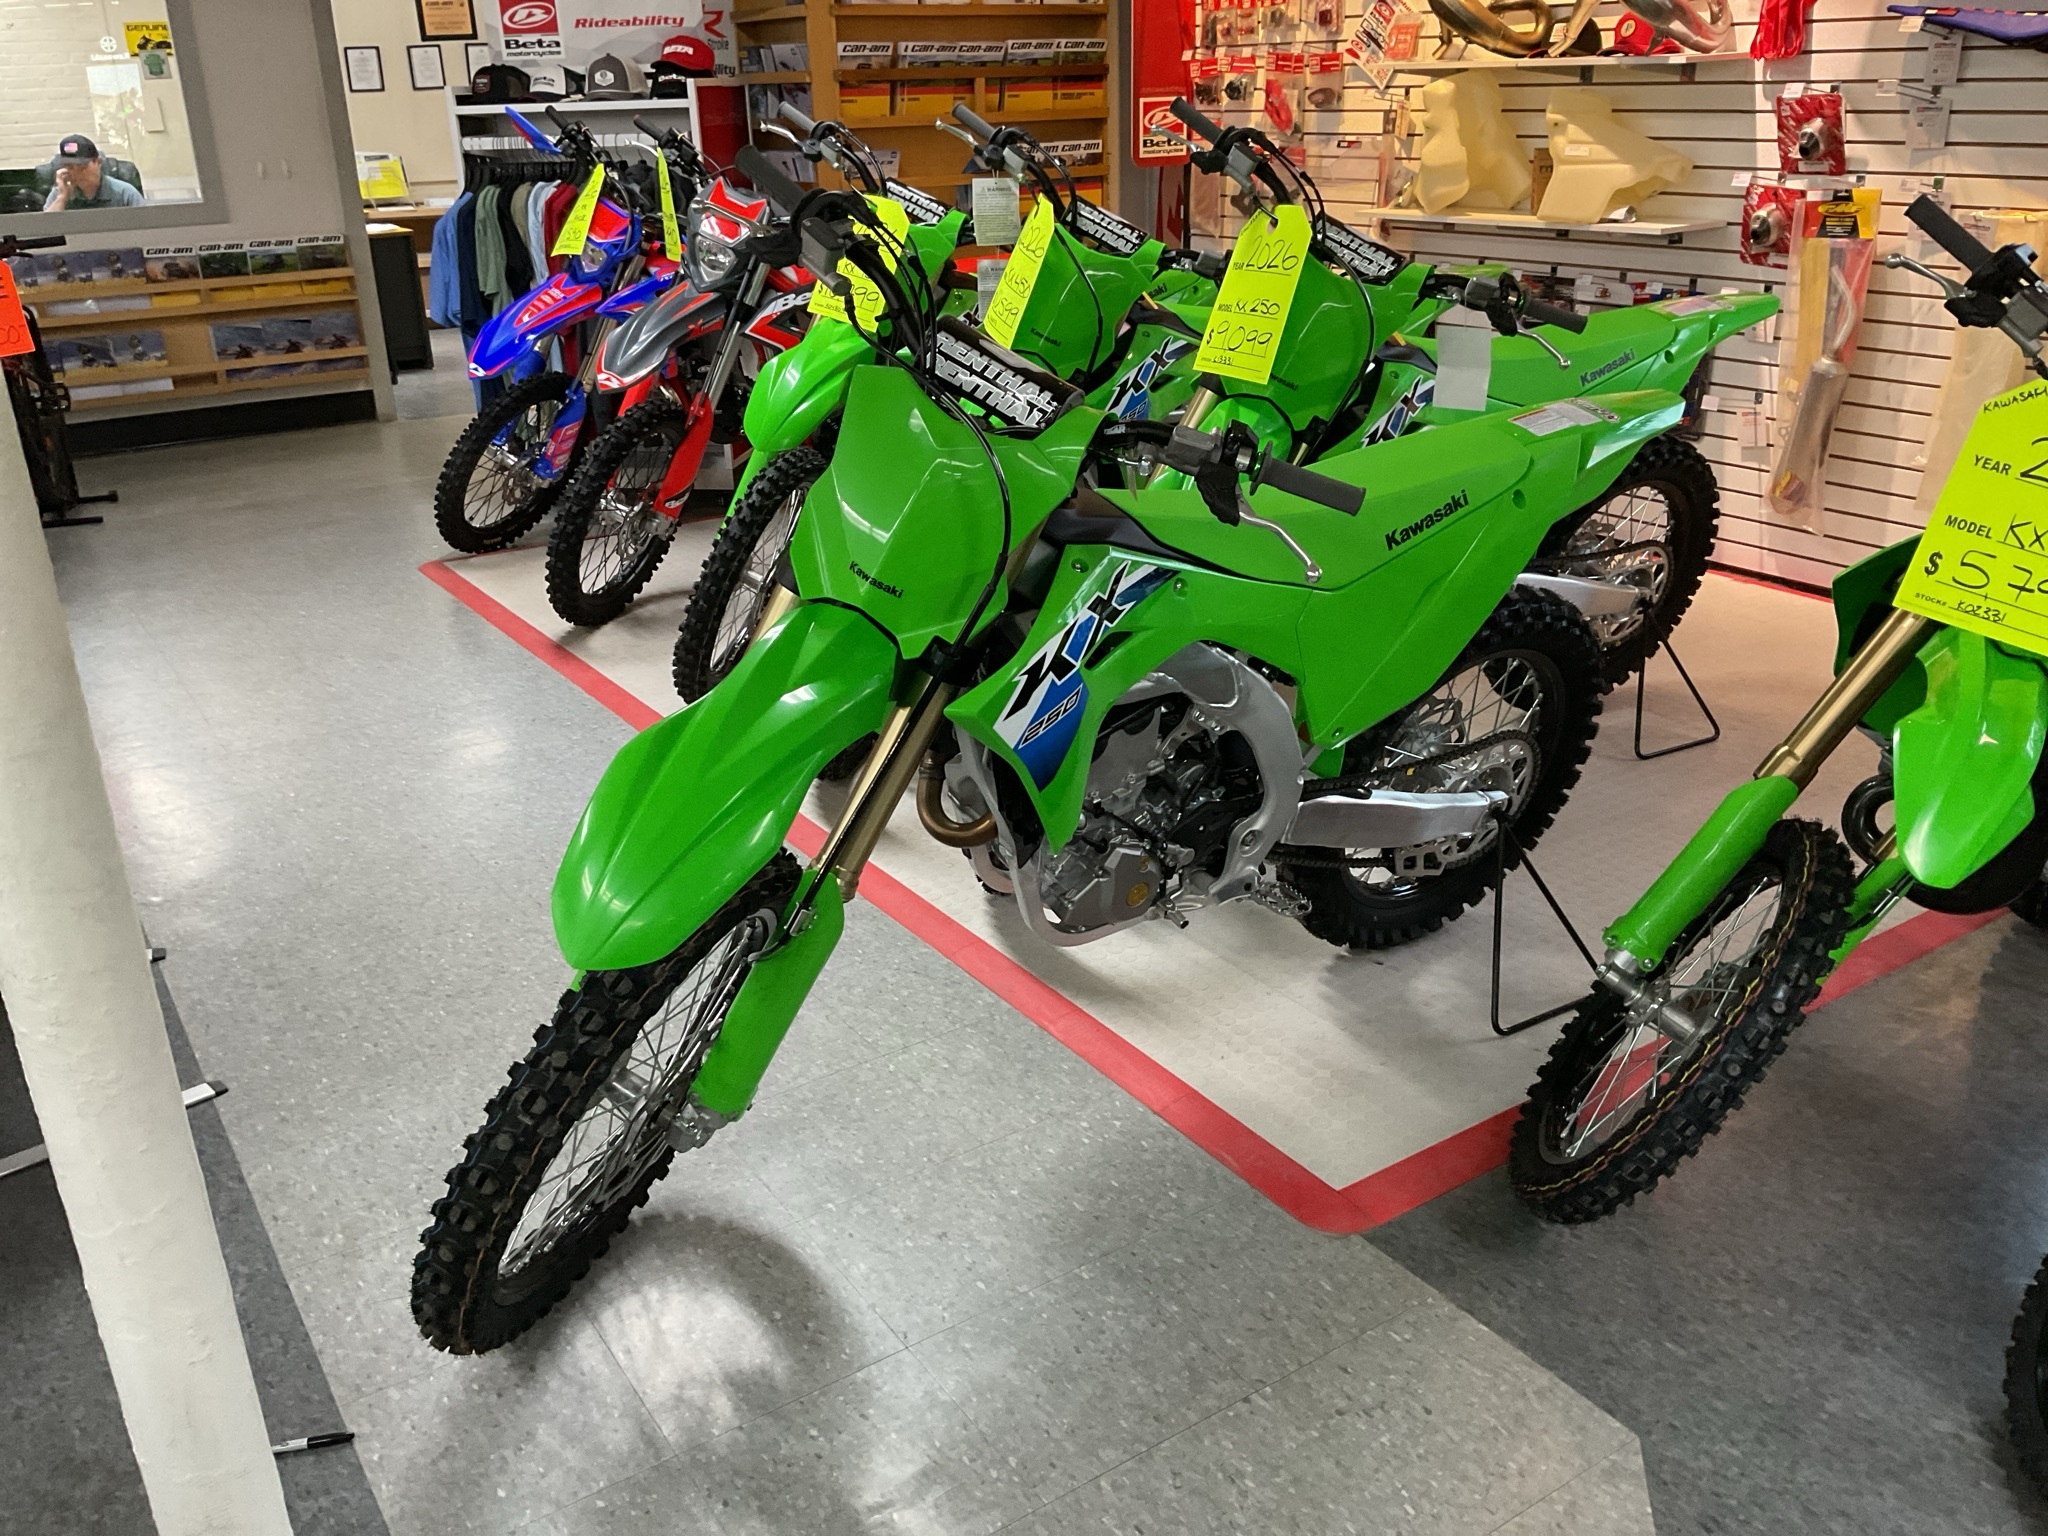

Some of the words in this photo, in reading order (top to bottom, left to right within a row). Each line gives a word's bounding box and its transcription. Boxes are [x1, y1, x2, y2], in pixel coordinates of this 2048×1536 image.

[574, 15, 684, 29] Rideability
[504, 38, 561, 50] Beta
[842, 43, 891, 54] can-am
[911, 43, 957, 53] can-am
[958, 44, 1004, 53] can-am
[1011, 41, 1054, 50] can-am
[1064, 40, 1105, 50] can-am
[506, 50, 561, 58] motorcycles
[1061, 142, 1101, 153] can-am
[249, 238, 293, 248] can-am
[297, 234, 341, 245] can-am
[146, 246, 193, 256] can-am
[199, 242, 243, 252] can-am
[1245, 234, 1299, 271] 2026
[1249, 299, 1281, 315] 250
[936, 330, 1056, 412] RENTHAL
[1579, 348, 1636, 387] Kawasaki
[1973, 454, 2012, 476] YEAR
[1384, 488, 1470, 551] Kawasaki
[1944, 514, 1993, 540] MODEL
[849, 559, 904, 599] Kawasaki
[1018, 683, 1085, 750] 250
